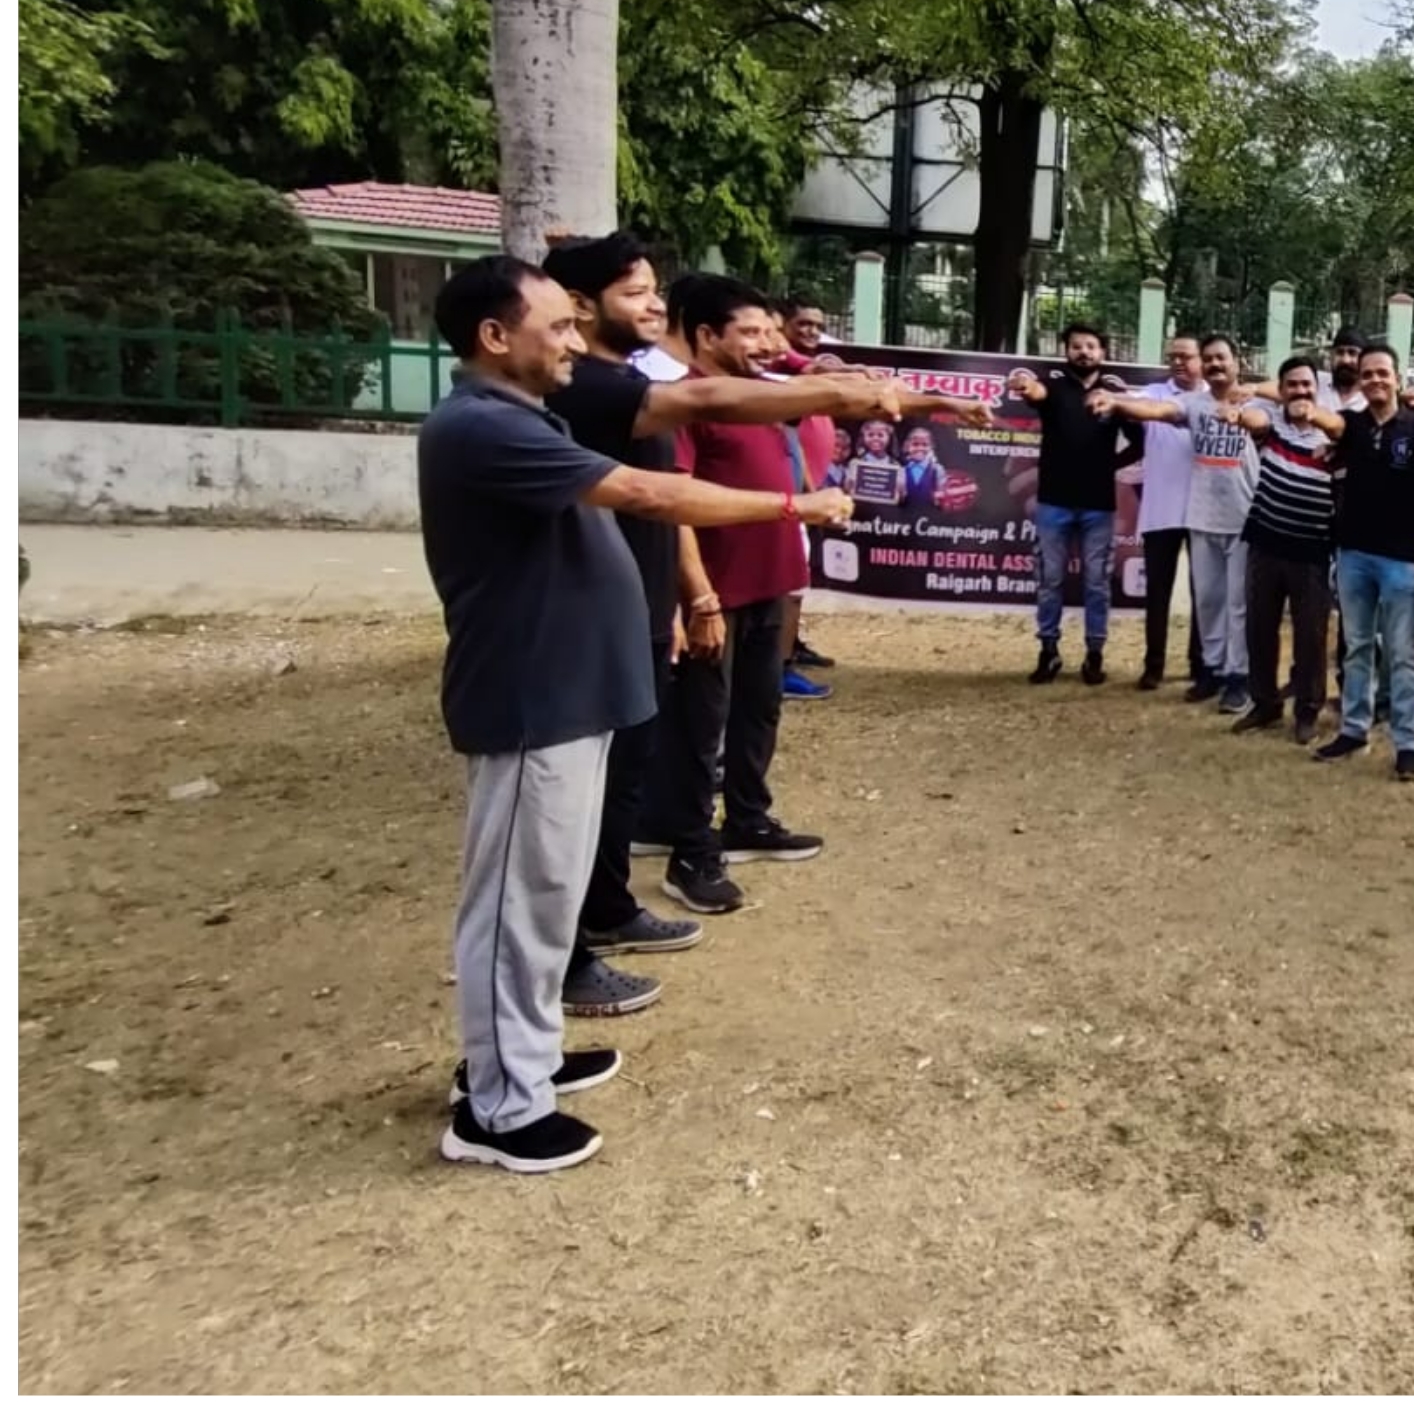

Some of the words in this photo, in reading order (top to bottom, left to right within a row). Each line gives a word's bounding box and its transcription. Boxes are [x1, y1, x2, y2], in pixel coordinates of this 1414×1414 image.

[970, 444, 1040, 458] INTERFEREN
[915, 517, 999, 544] Campaign
[870, 547, 928, 567] INDIAN
[934, 552, 997, 570] DENTAL
[926, 571, 992, 596] Raigarh
[997, 575, 1040, 593] Bran
